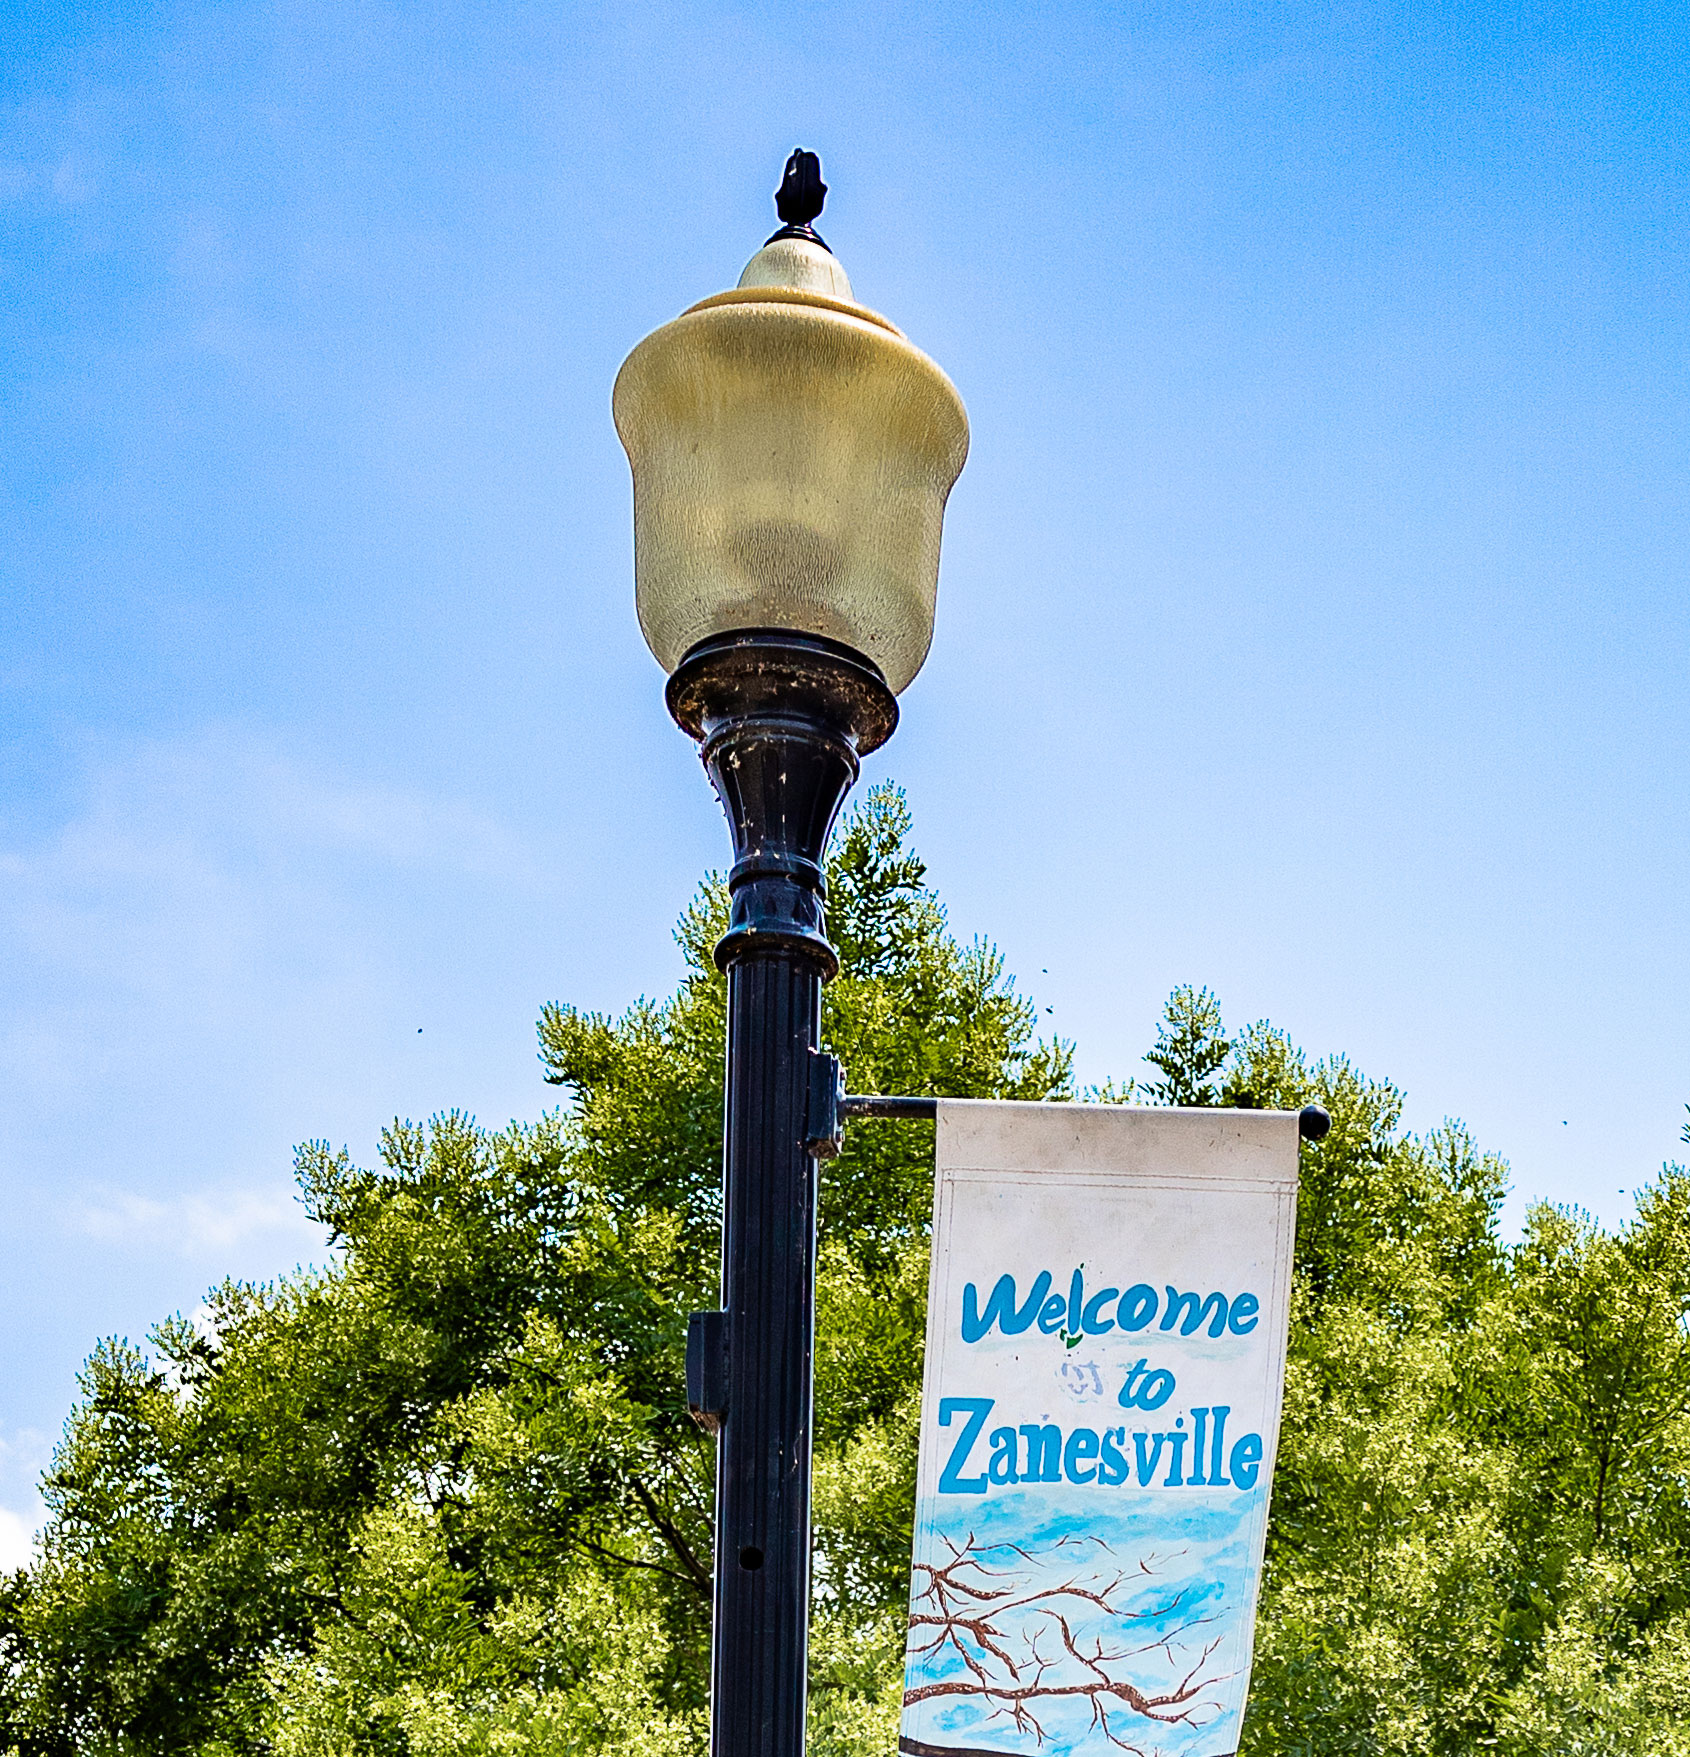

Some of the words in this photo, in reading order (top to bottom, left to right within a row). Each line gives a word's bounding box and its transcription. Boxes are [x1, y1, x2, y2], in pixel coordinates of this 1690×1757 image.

[961, 1268, 1259, 1343] Welcome
[1118, 1358, 1176, 1411] to
[938, 1397, 1263, 1493] Zanesville
